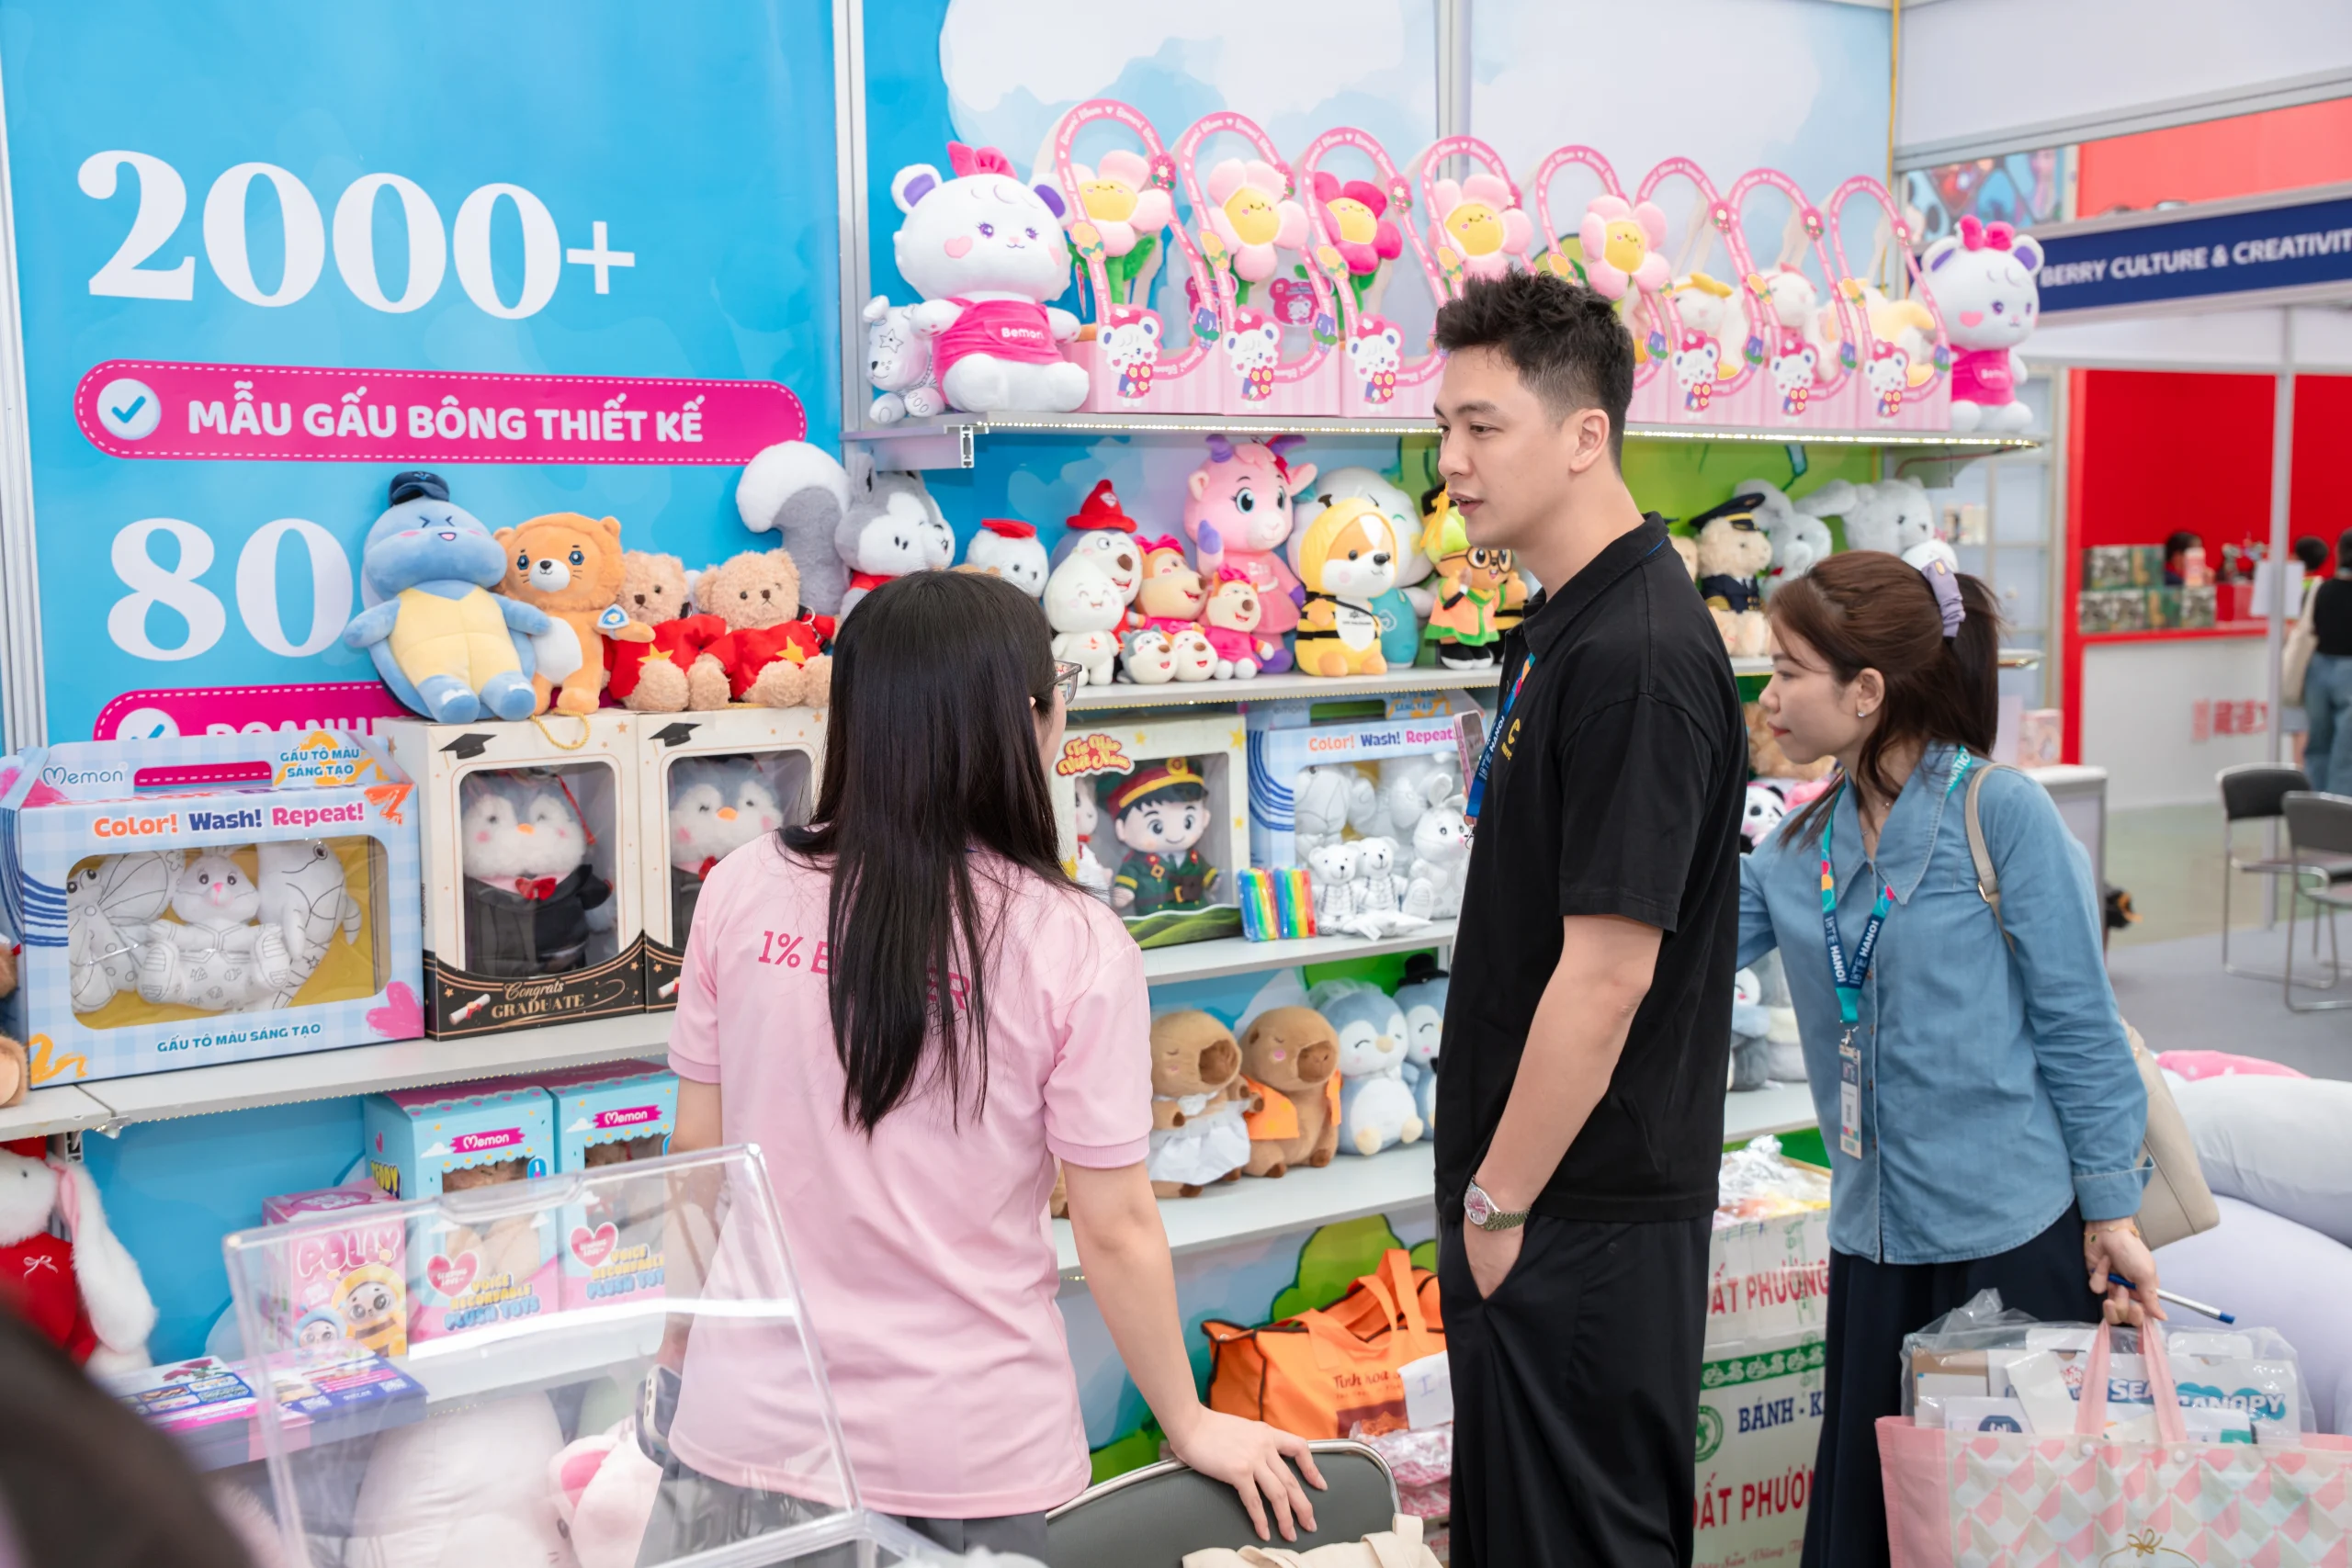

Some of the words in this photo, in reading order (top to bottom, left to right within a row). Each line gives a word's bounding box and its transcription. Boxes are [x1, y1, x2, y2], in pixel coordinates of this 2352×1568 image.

[77, 150, 636, 320] 2000+
[2040, 258, 2107, 288] BERRY
[2109, 246, 2208, 279] CULTURE
[2211, 244, 2229, 266] &
[187, 381, 292, 435] MẪU
[303, 388, 397, 439] GẤU
[409, 395, 527, 442] BÔNG
[536, 393, 648, 443] THIẾT
[656, 395, 704, 443] KẾ
[107, 517, 384, 660] 80
[1308, 735, 1354, 752] Color!
[1361, 731, 1400, 747] Wash!
[1489, 715, 1506, 753] HANOI
[280, 747, 309, 762] GẤU
[311, 747, 329, 761] TÔ
[332, 745, 360, 760] MÀU
[288, 762, 322, 778] SÁNG
[323, 762, 355, 779] TẠO
[42, 765, 124, 788] Memon
[93, 814, 178, 839] Color!
[188, 809, 263, 831] Wash!
[272, 803, 365, 828] Repeat!
[758, 930, 804, 969] 1%
[1859, 919, 1880, 958] HANOI
[1830, 945, 1848, 983] HANOI
[492, 994, 584, 1020] GRADUATE
[503, 980, 564, 1001] Congrats
[157, 1035, 189, 1054] GẤU
[192, 1033, 212, 1048] TÔ
[216, 1029, 247, 1045] MÀU
[250, 1025, 288, 1042] SÁNG
[291, 1023, 322, 1039] TẠO
[605, 1110, 648, 1125] Memon
[463, 1133, 509, 1149] Memon
[586, 1275, 635, 1300] PLUSH
[637, 1269, 664, 1289] TOY
[1707, 1262, 1738, 1314] ẤT
[445, 1304, 499, 1331] PLUSH
[500, 1296, 540, 1320] TOYS
[1738, 1395, 1794, 1433] BÁNH
[1741, 1463, 1814, 1522] PHƯƠ
